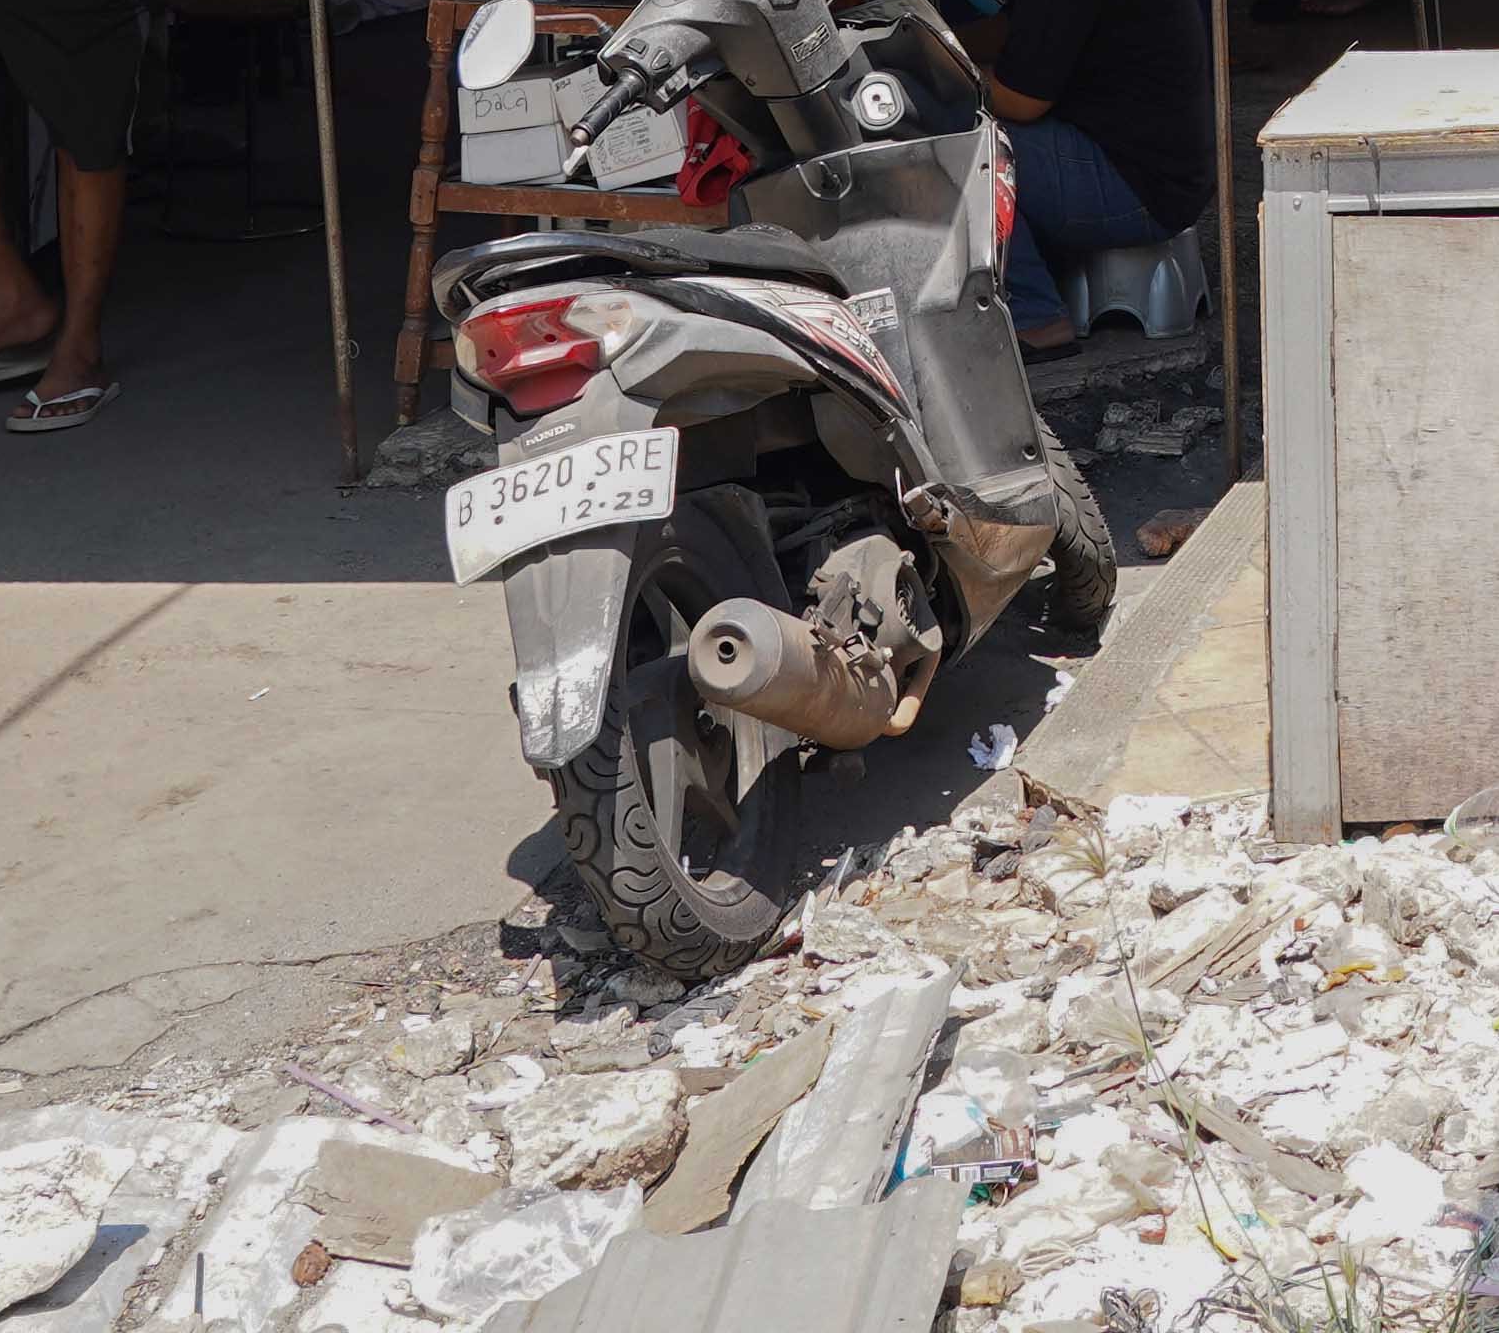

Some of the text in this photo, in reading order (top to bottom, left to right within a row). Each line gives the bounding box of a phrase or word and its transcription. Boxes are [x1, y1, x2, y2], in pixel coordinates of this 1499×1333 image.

[525, 421, 576, 447] HONDA
[458, 437, 664, 527] B 3620 SRE
